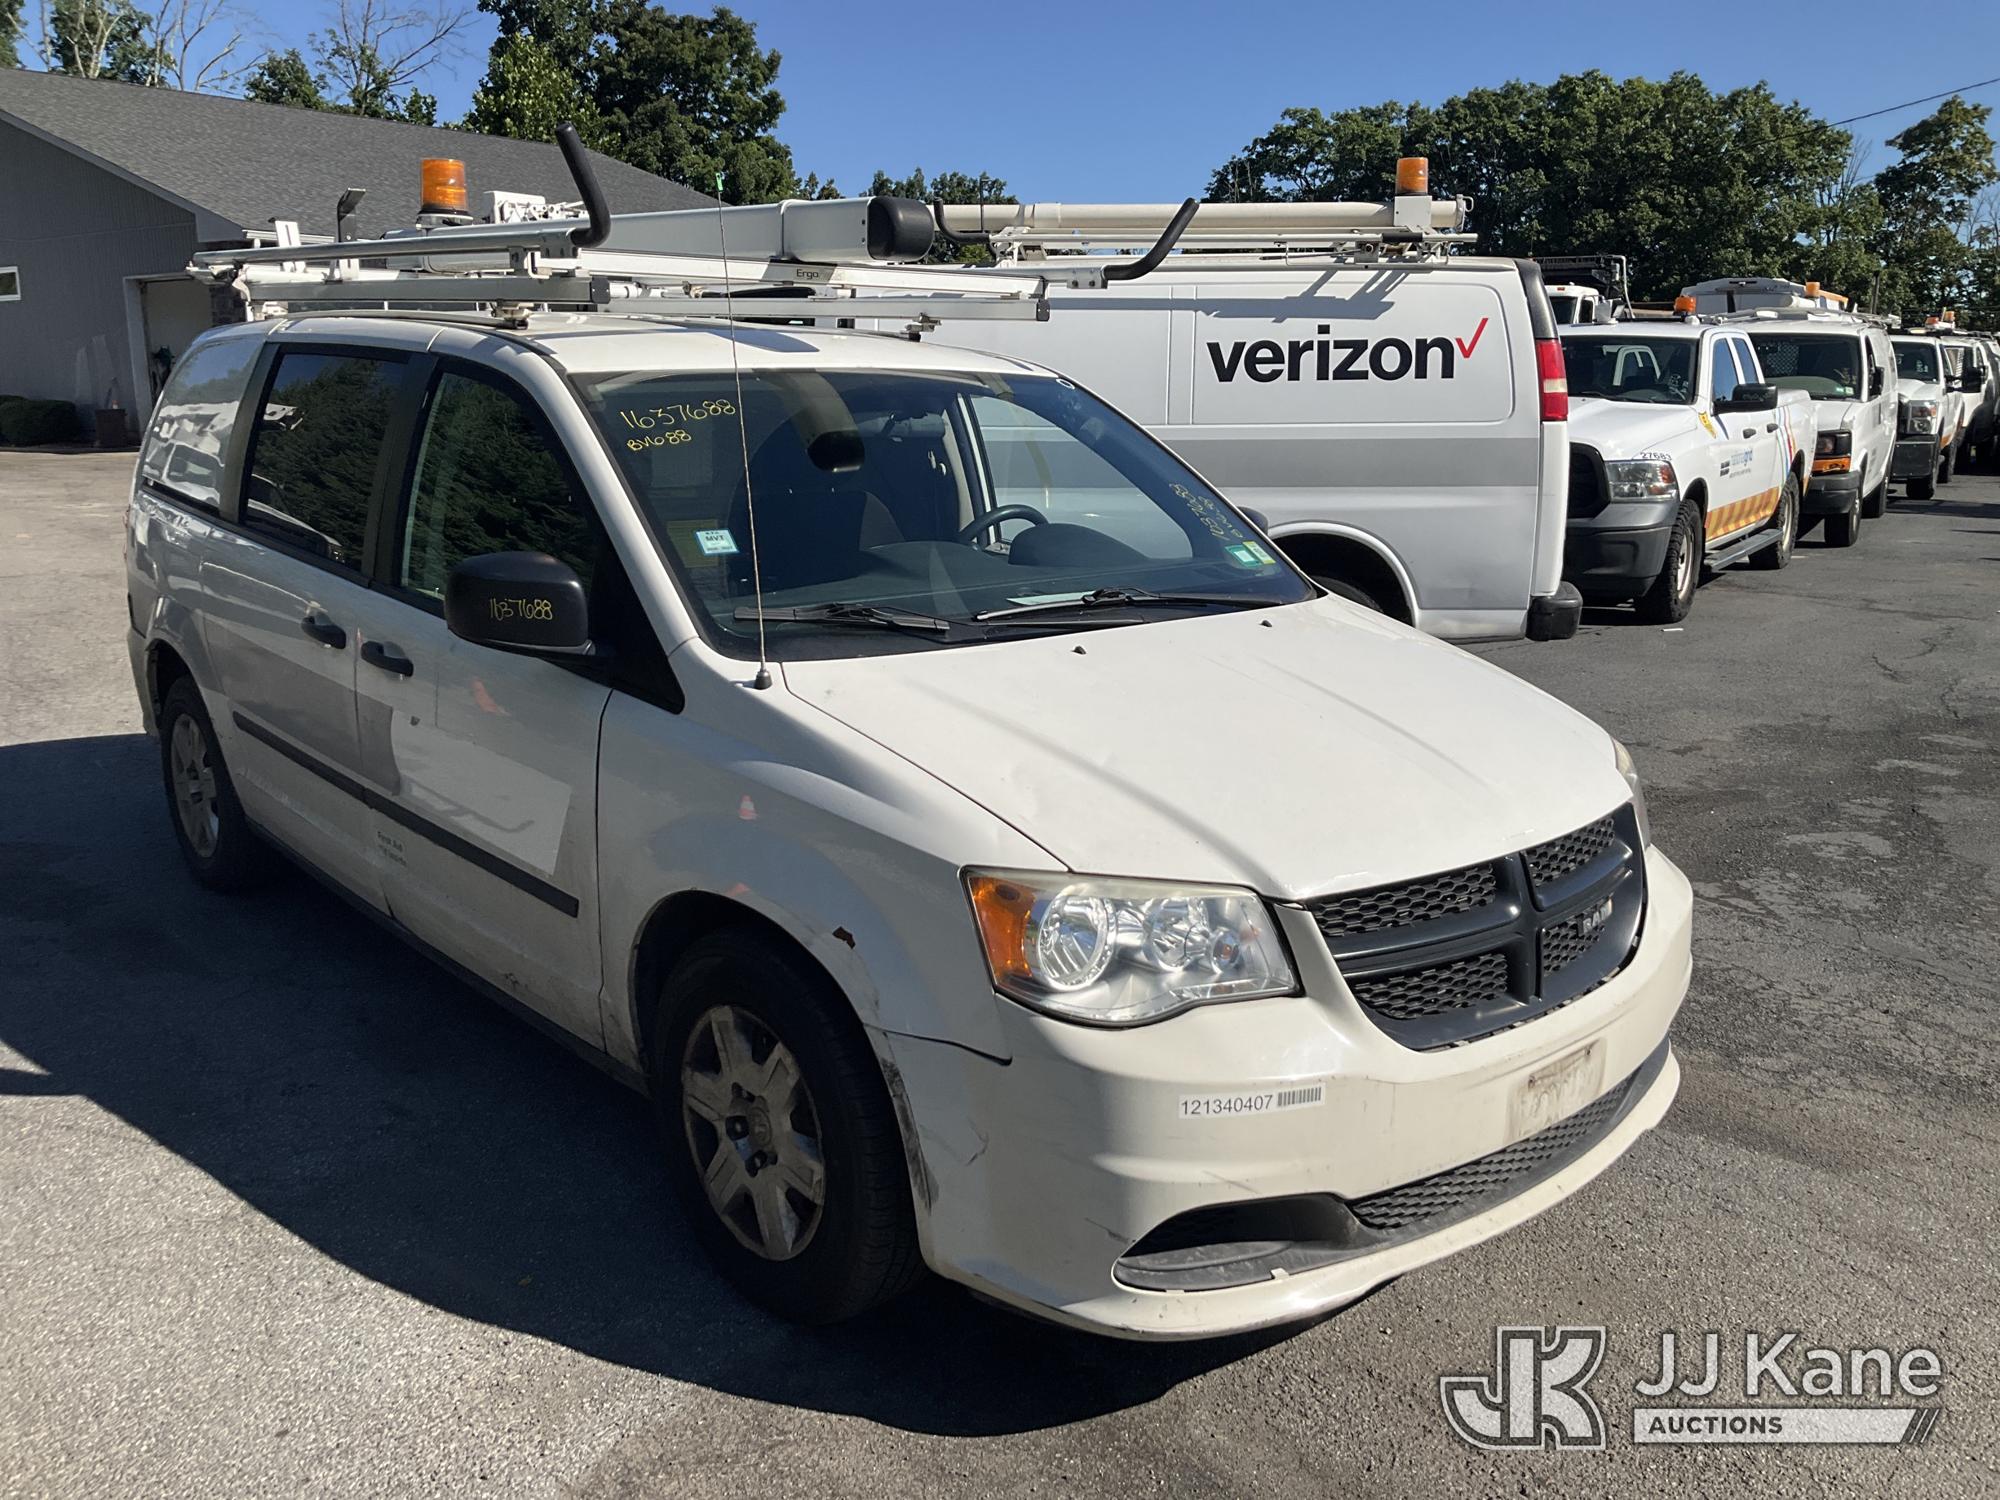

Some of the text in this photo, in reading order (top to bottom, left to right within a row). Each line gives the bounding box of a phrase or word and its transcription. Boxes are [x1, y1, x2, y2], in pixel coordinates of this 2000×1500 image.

[796, 268, 819, 280] Ergo
[1206, 324, 1454, 382] verizon
[620, 399, 736, 428] 1637688
[489, 598, 553, 621] 1637688
[1181, 1094, 1274, 1115] 121340407
